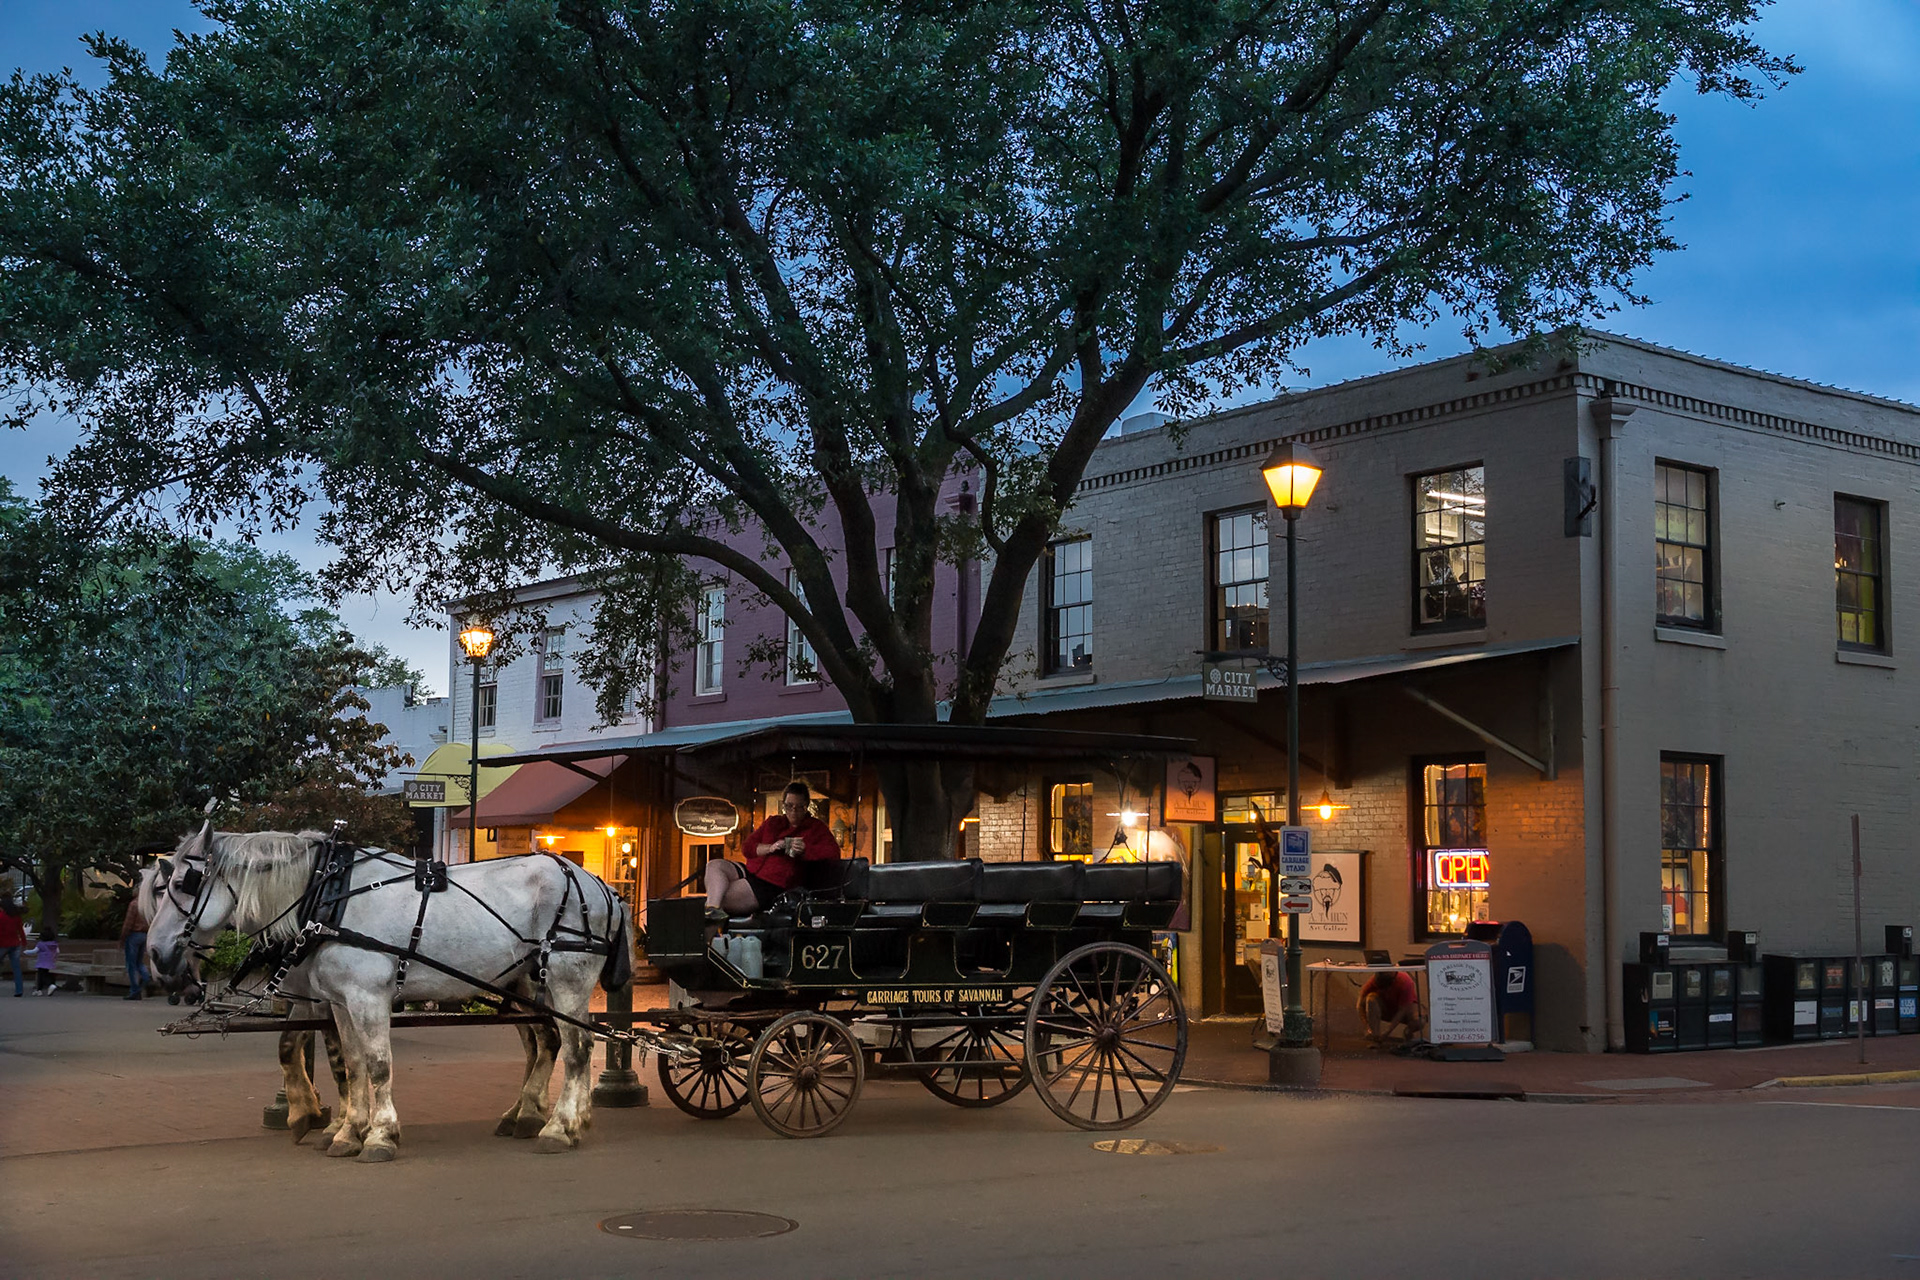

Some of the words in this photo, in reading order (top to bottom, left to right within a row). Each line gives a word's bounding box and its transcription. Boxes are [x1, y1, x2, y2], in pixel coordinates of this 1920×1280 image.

[1224, 671, 1251, 685] CITY
[1206, 683, 1256, 698] MARKET
[419, 783, 441, 792] CITY
[405, 791, 444, 800] MARKET
[686, 823, 708, 831] Tasting
[1281, 856, 1310, 864] CARRIAGE
[1330, 912, 1348, 922] HUN
[802, 944, 845, 970] 627
[1437, 963, 1464, 977] CARRIAGE
[1465, 963, 1483, 976] TOURS
[1449, 982, 1480, 991] SAVANNAH
[867, 990, 909, 1004] CARRIAGE
[912, 989, 942, 1003] TOURS
[943, 989, 955, 1003] OF
[958, 988, 1003, 1002] SAVANNAH
[1437, 1033, 1485, 1041] 912-236-6756
